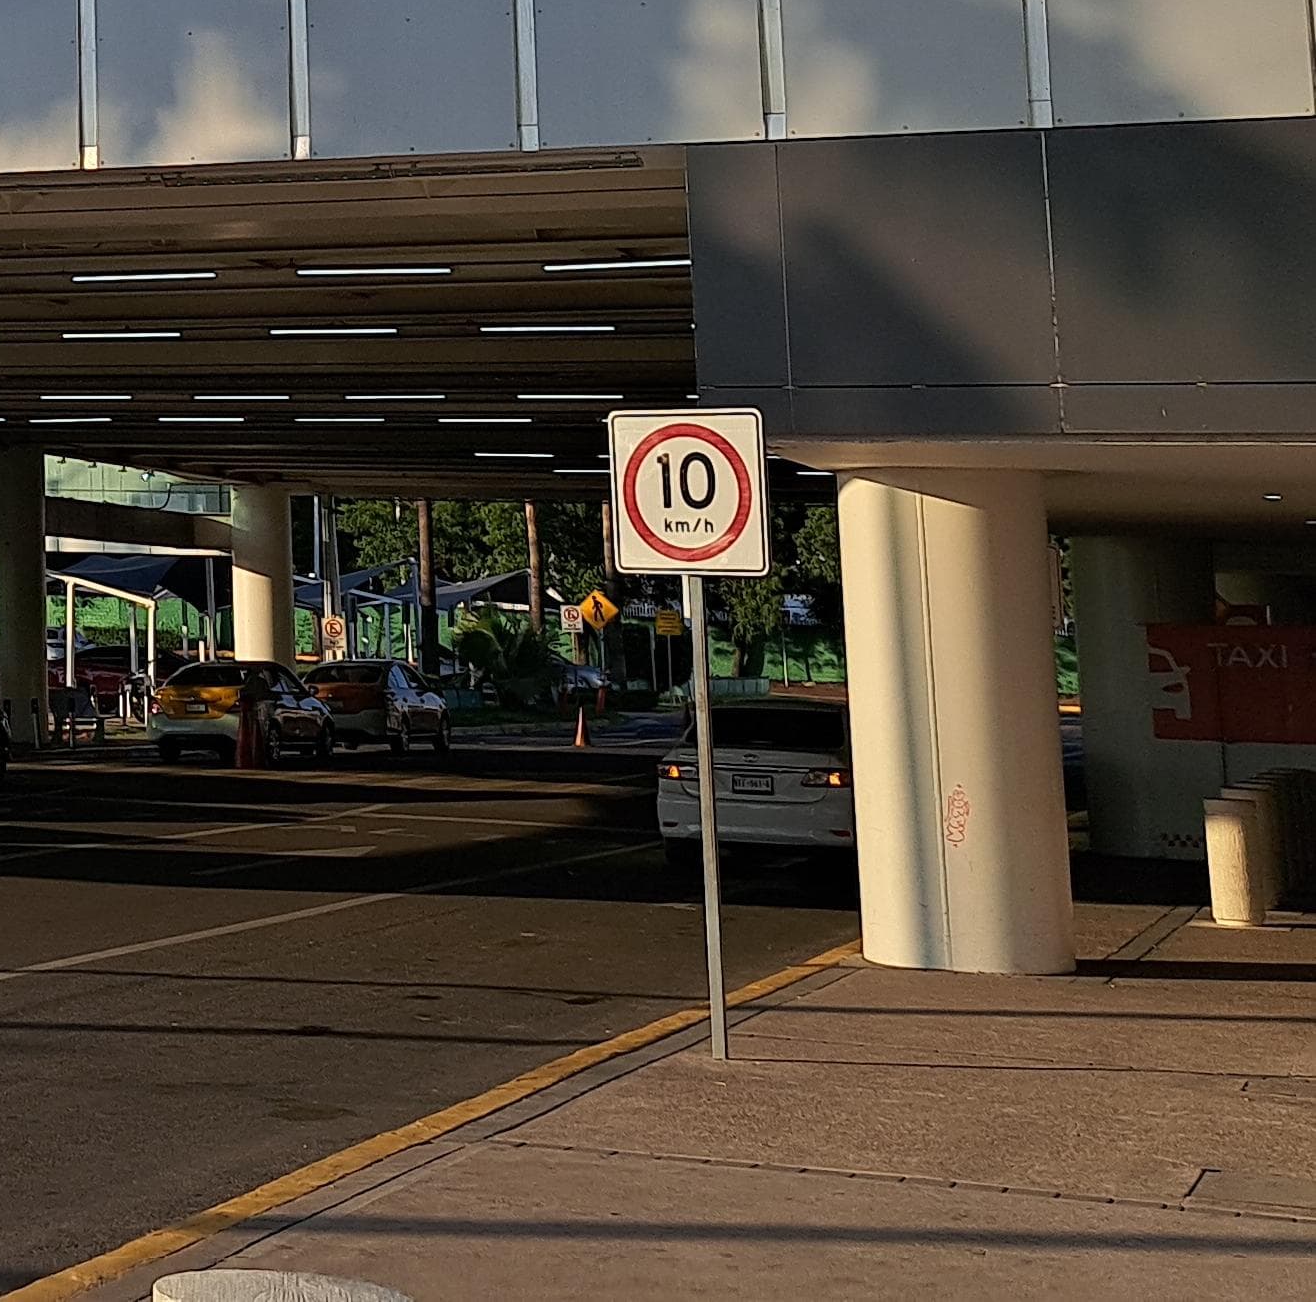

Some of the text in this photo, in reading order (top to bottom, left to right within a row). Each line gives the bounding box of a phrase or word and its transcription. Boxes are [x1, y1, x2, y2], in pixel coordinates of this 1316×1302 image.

[657, 452, 716, 510] 10
[664, 518, 714, 533] km/h
[1206, 642, 1288, 668] TAXI
